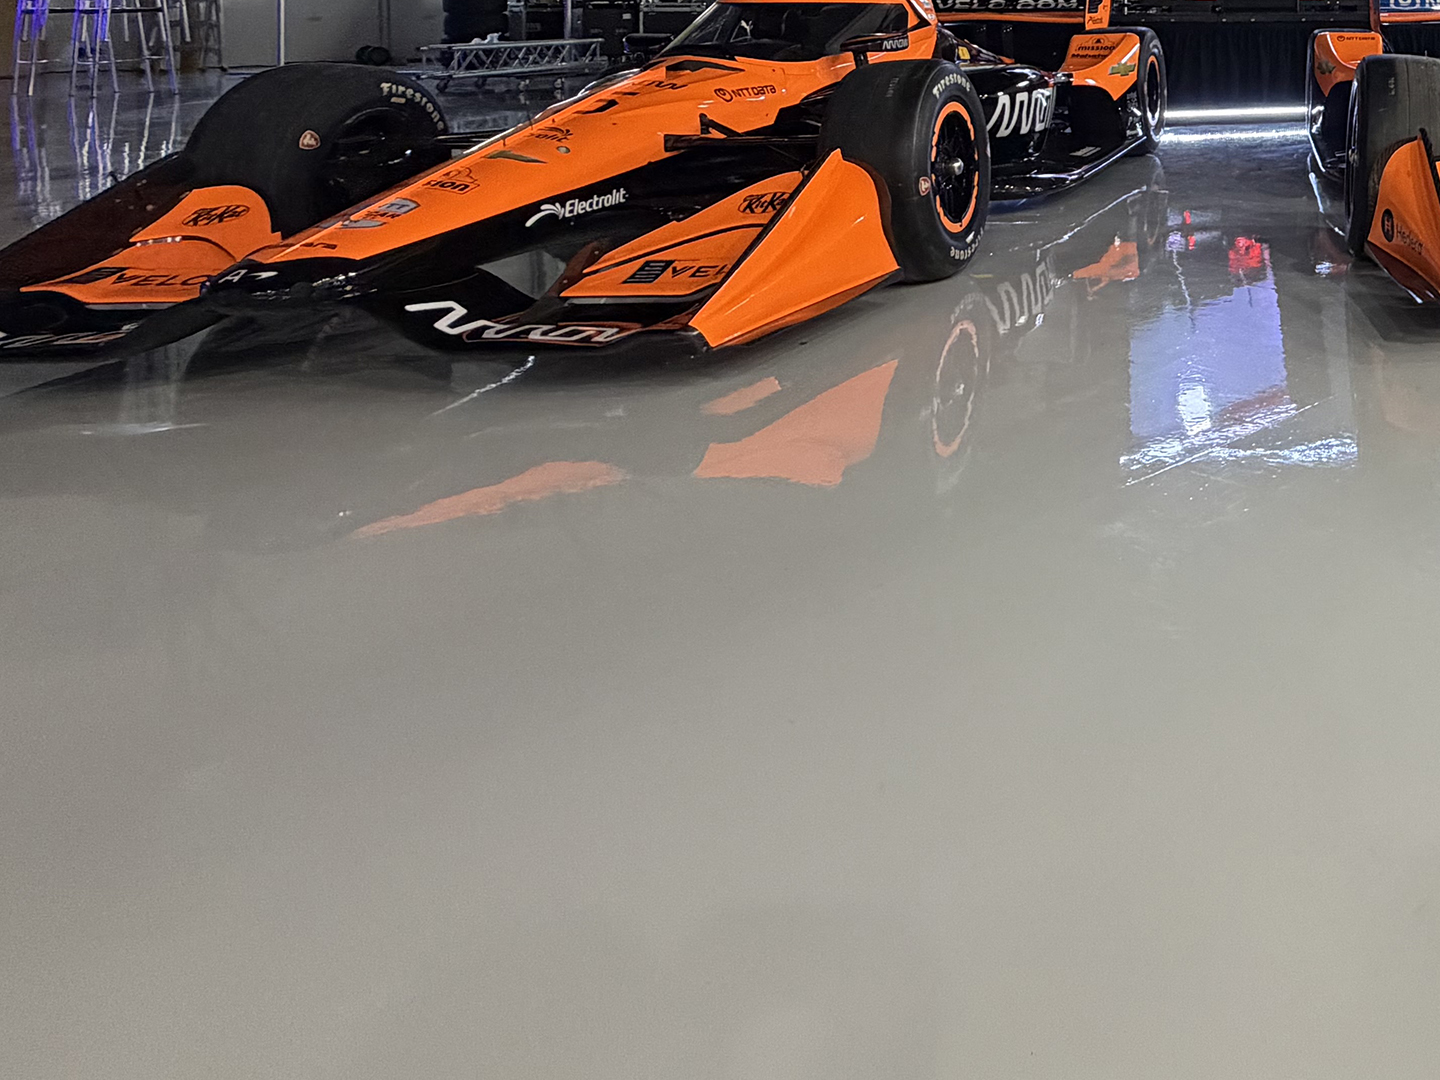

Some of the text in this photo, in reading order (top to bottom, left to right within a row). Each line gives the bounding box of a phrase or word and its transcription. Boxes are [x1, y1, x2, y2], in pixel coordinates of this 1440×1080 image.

[734, 88, 753, 98] NTT
[932, 72, 972, 100] Firestone
[380, 82, 445, 131] Firestone
[564, 189, 626, 218] Electrolit
